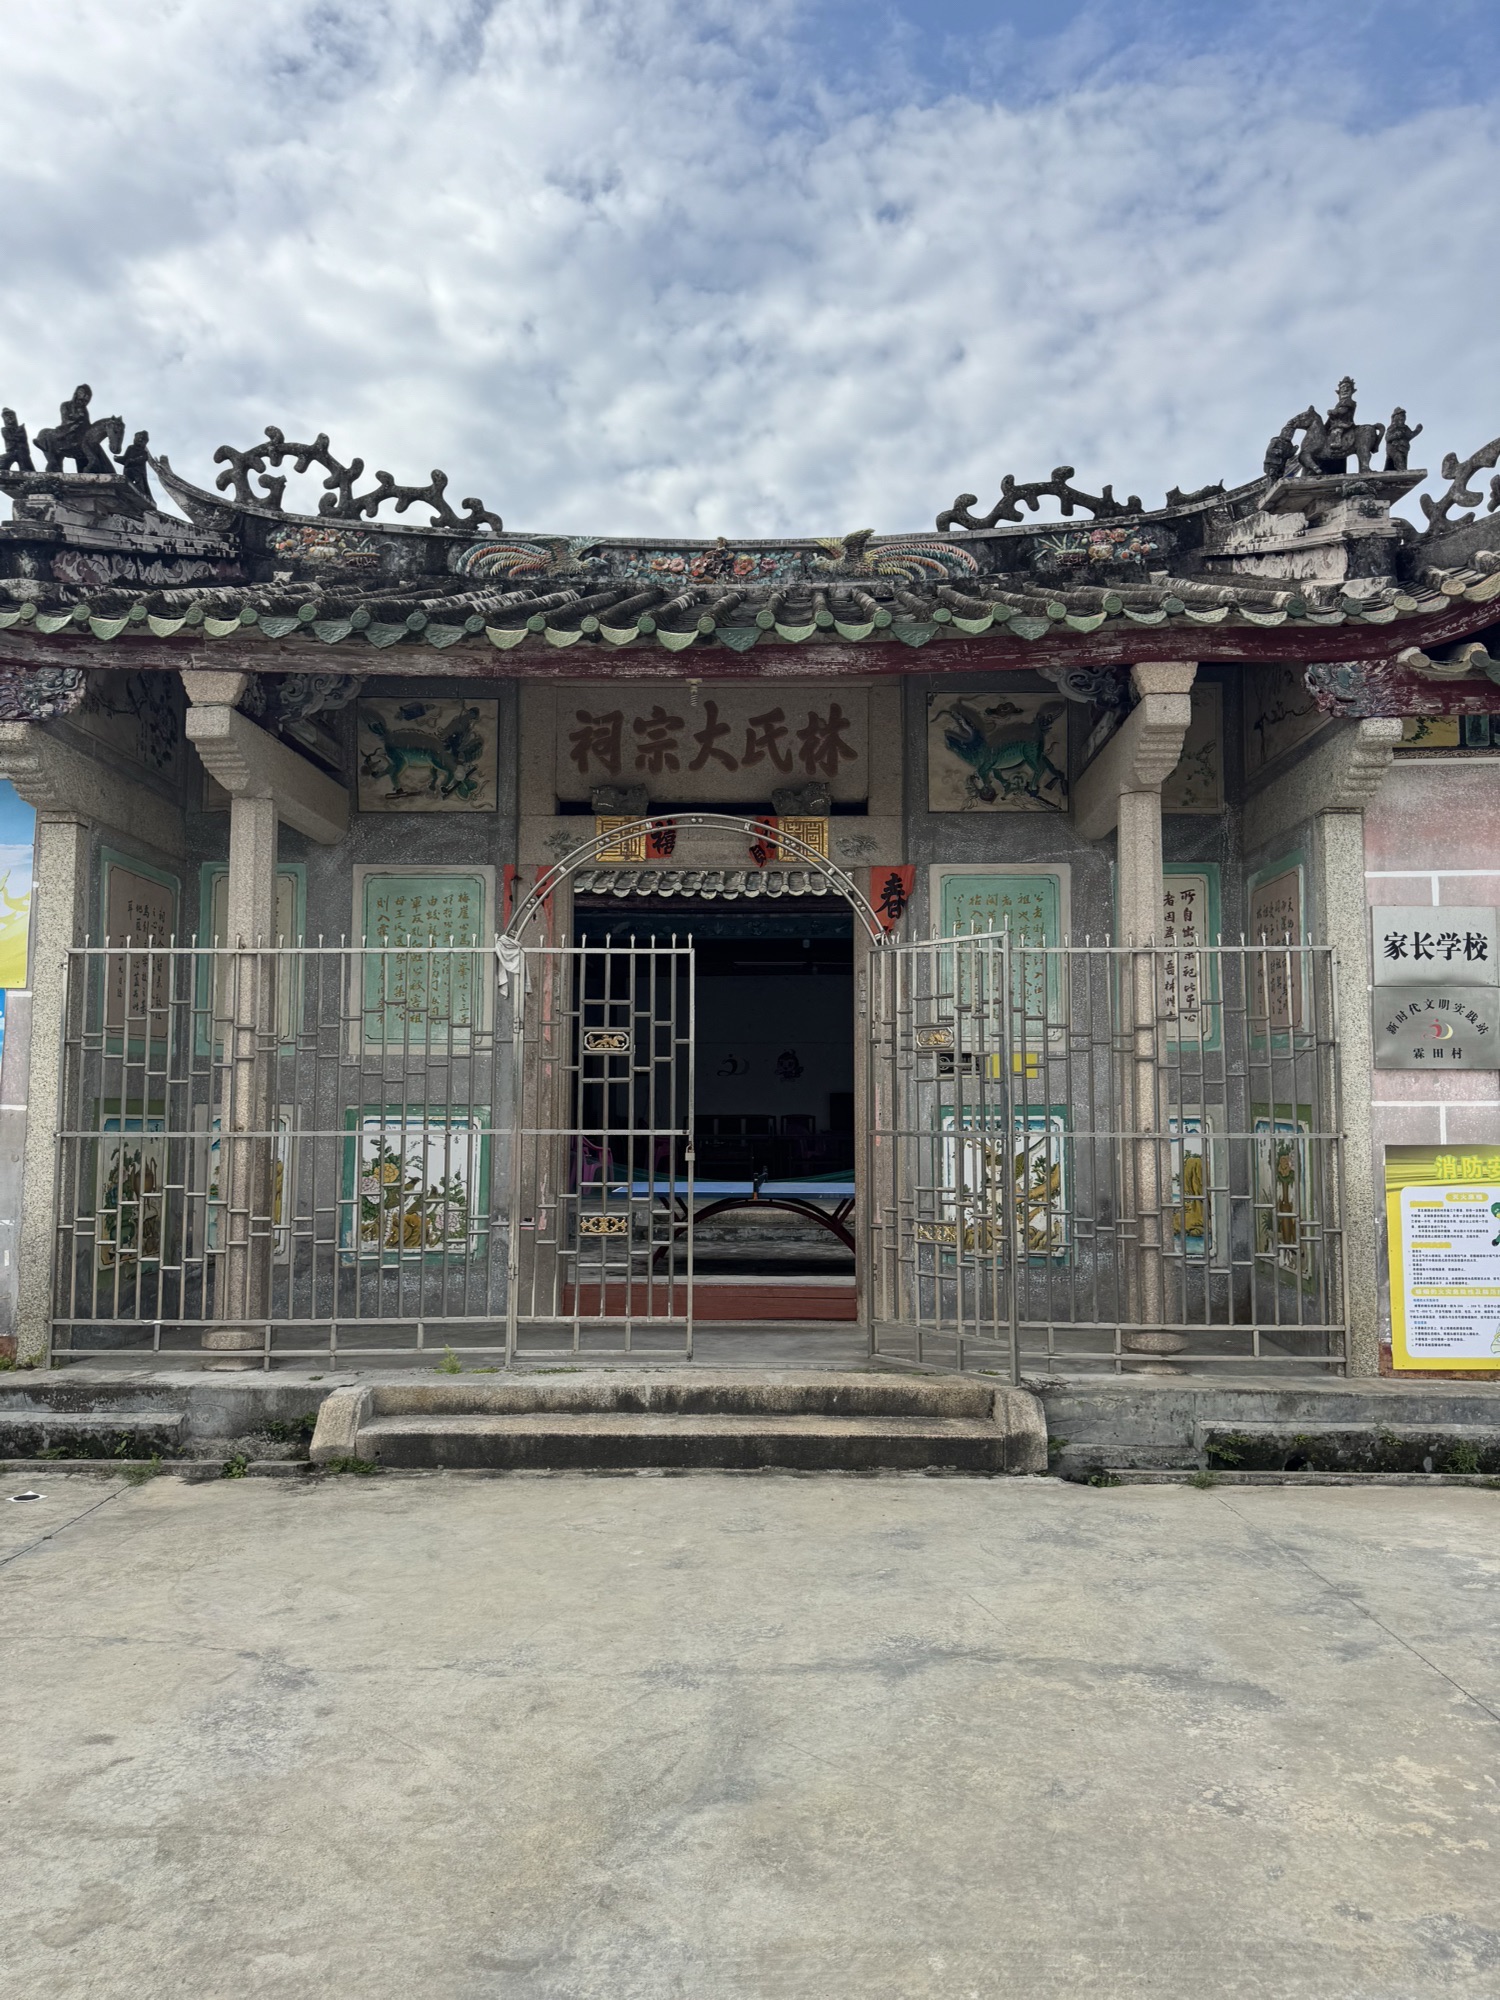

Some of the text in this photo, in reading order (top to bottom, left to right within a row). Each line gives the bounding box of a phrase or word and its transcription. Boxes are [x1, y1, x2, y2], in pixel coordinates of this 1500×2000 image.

[568, 700, 859, 777] 林氏大宗祠
[875, 872, 907, 919] 春
[1384, 932, 1489, 961] 家长学校
[1386, 999, 1490, 1036] 新时代文明实践站
[1413, 1048, 1463, 1060] 霖田村
